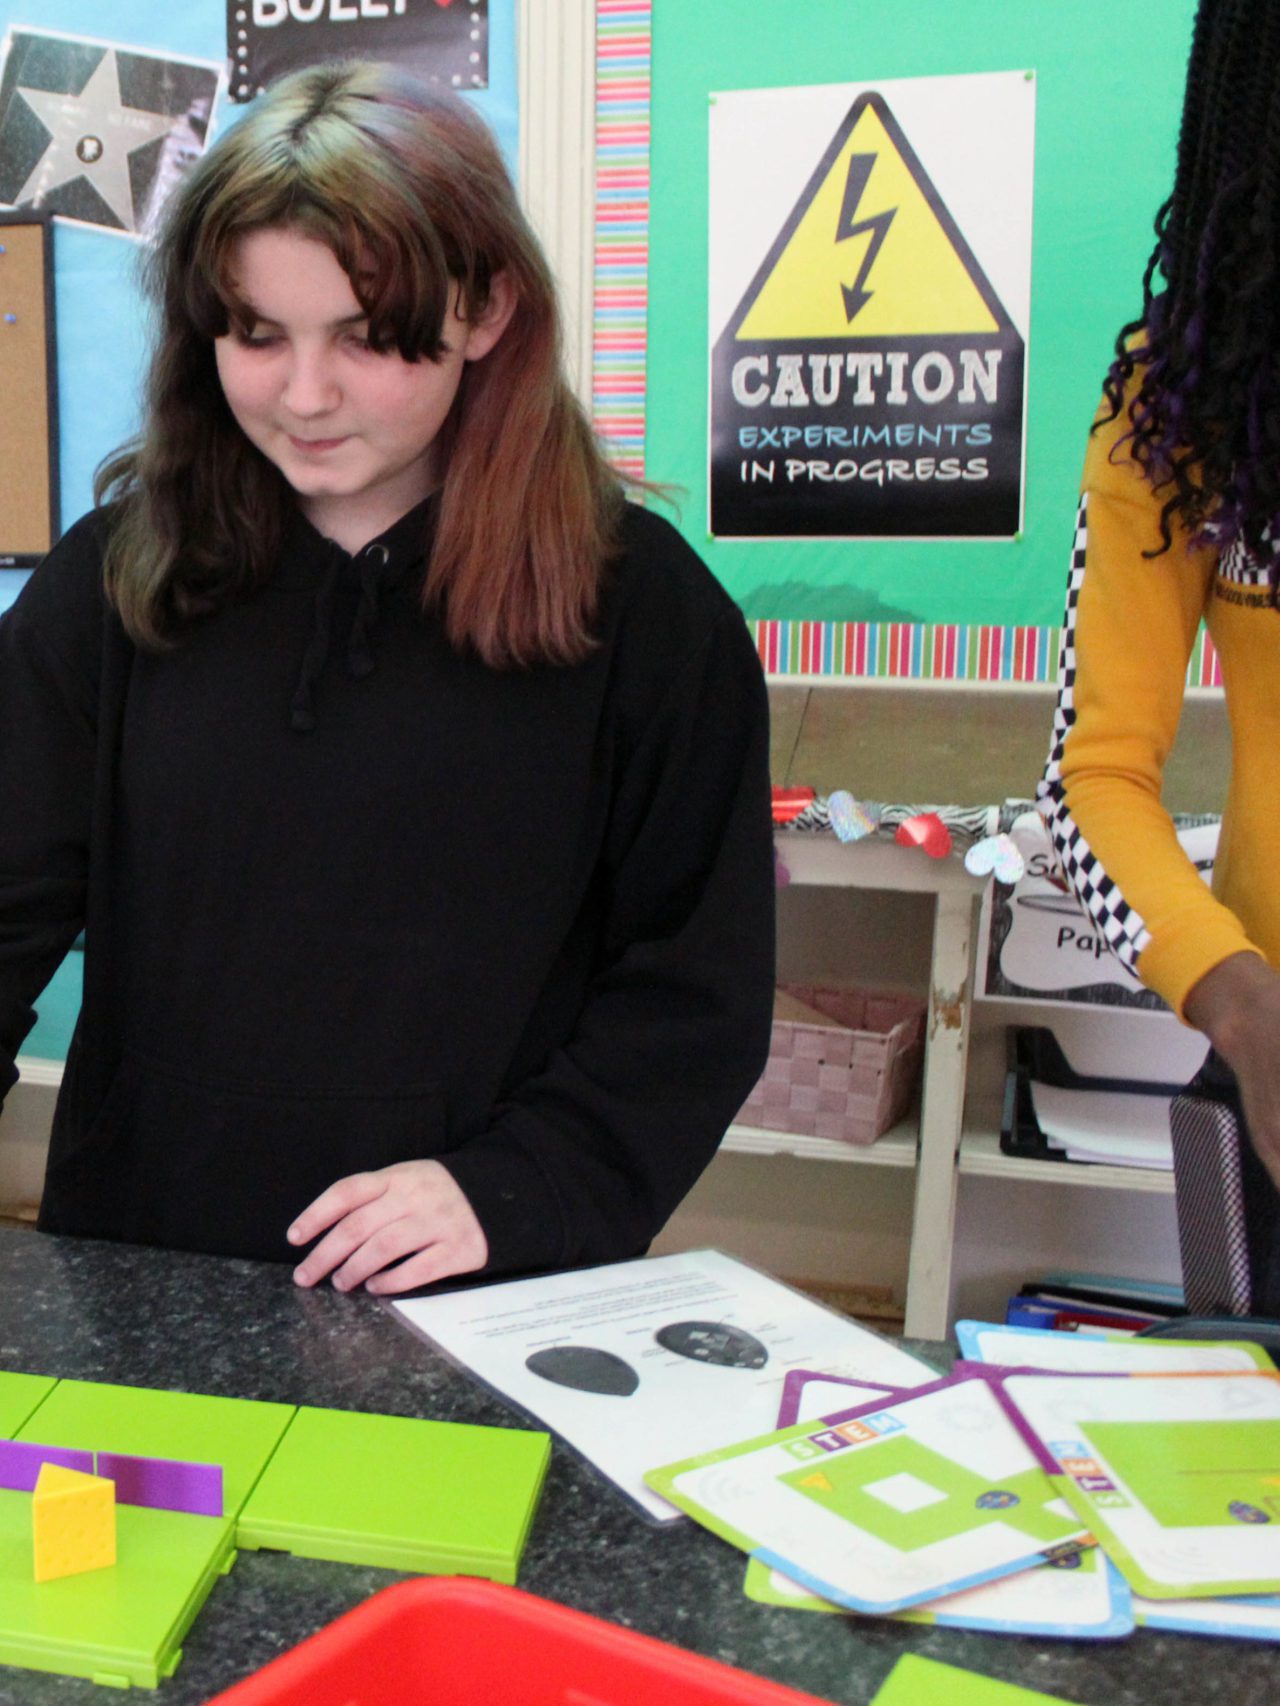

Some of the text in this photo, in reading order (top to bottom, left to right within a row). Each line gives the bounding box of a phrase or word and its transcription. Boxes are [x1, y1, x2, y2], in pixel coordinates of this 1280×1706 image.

[731, 349, 1003, 408] CAUTION
[738, 422, 993, 450] EXPERIMENTS
[740, 457, 990, 488] IN PROGRESS
[788, 1414, 902, 1459] STEM
